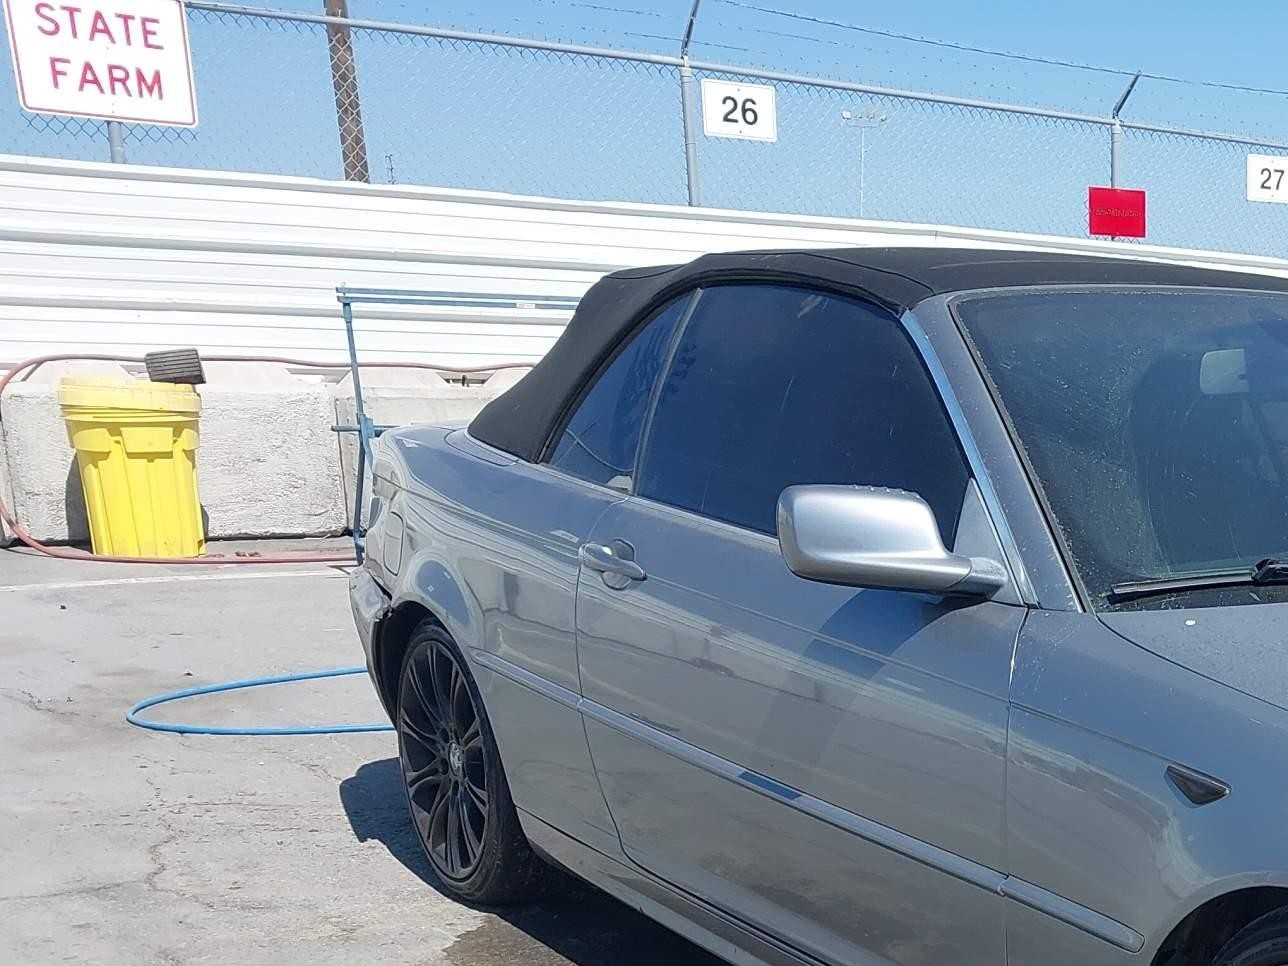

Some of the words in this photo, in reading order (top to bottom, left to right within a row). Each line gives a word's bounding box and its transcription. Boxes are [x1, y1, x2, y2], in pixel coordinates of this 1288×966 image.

[35, 2, 165, 50] STATE
[49, 56, 164, 101] FARM
[722, 95, 758, 126] 26
[1260, 167, 1285, 190] 27
